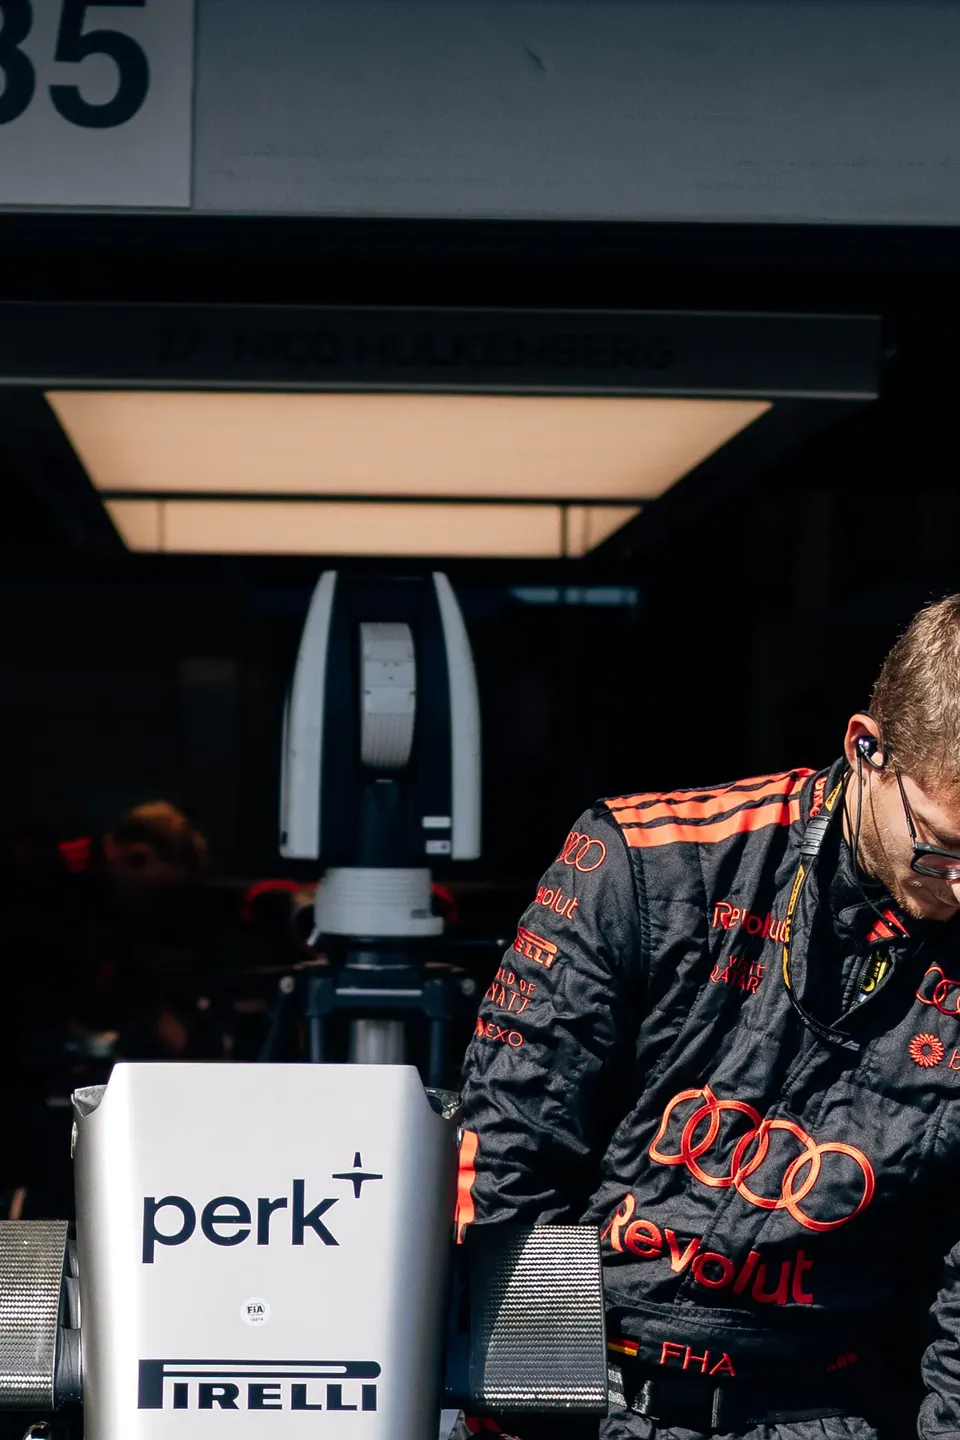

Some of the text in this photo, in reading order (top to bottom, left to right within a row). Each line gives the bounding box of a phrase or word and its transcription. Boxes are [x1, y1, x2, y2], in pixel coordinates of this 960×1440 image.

[232, 327, 342, 367] NICO
[519, 979, 536, 996] OF
[141, 1178, 340, 1264] perk
[600, 1193, 814, 1305] Revolut
[247, 1304, 265, 1315] FIA
[660, 1340, 737, 1378] FHA
[137, 1358, 382, 1412] PIRELLI
